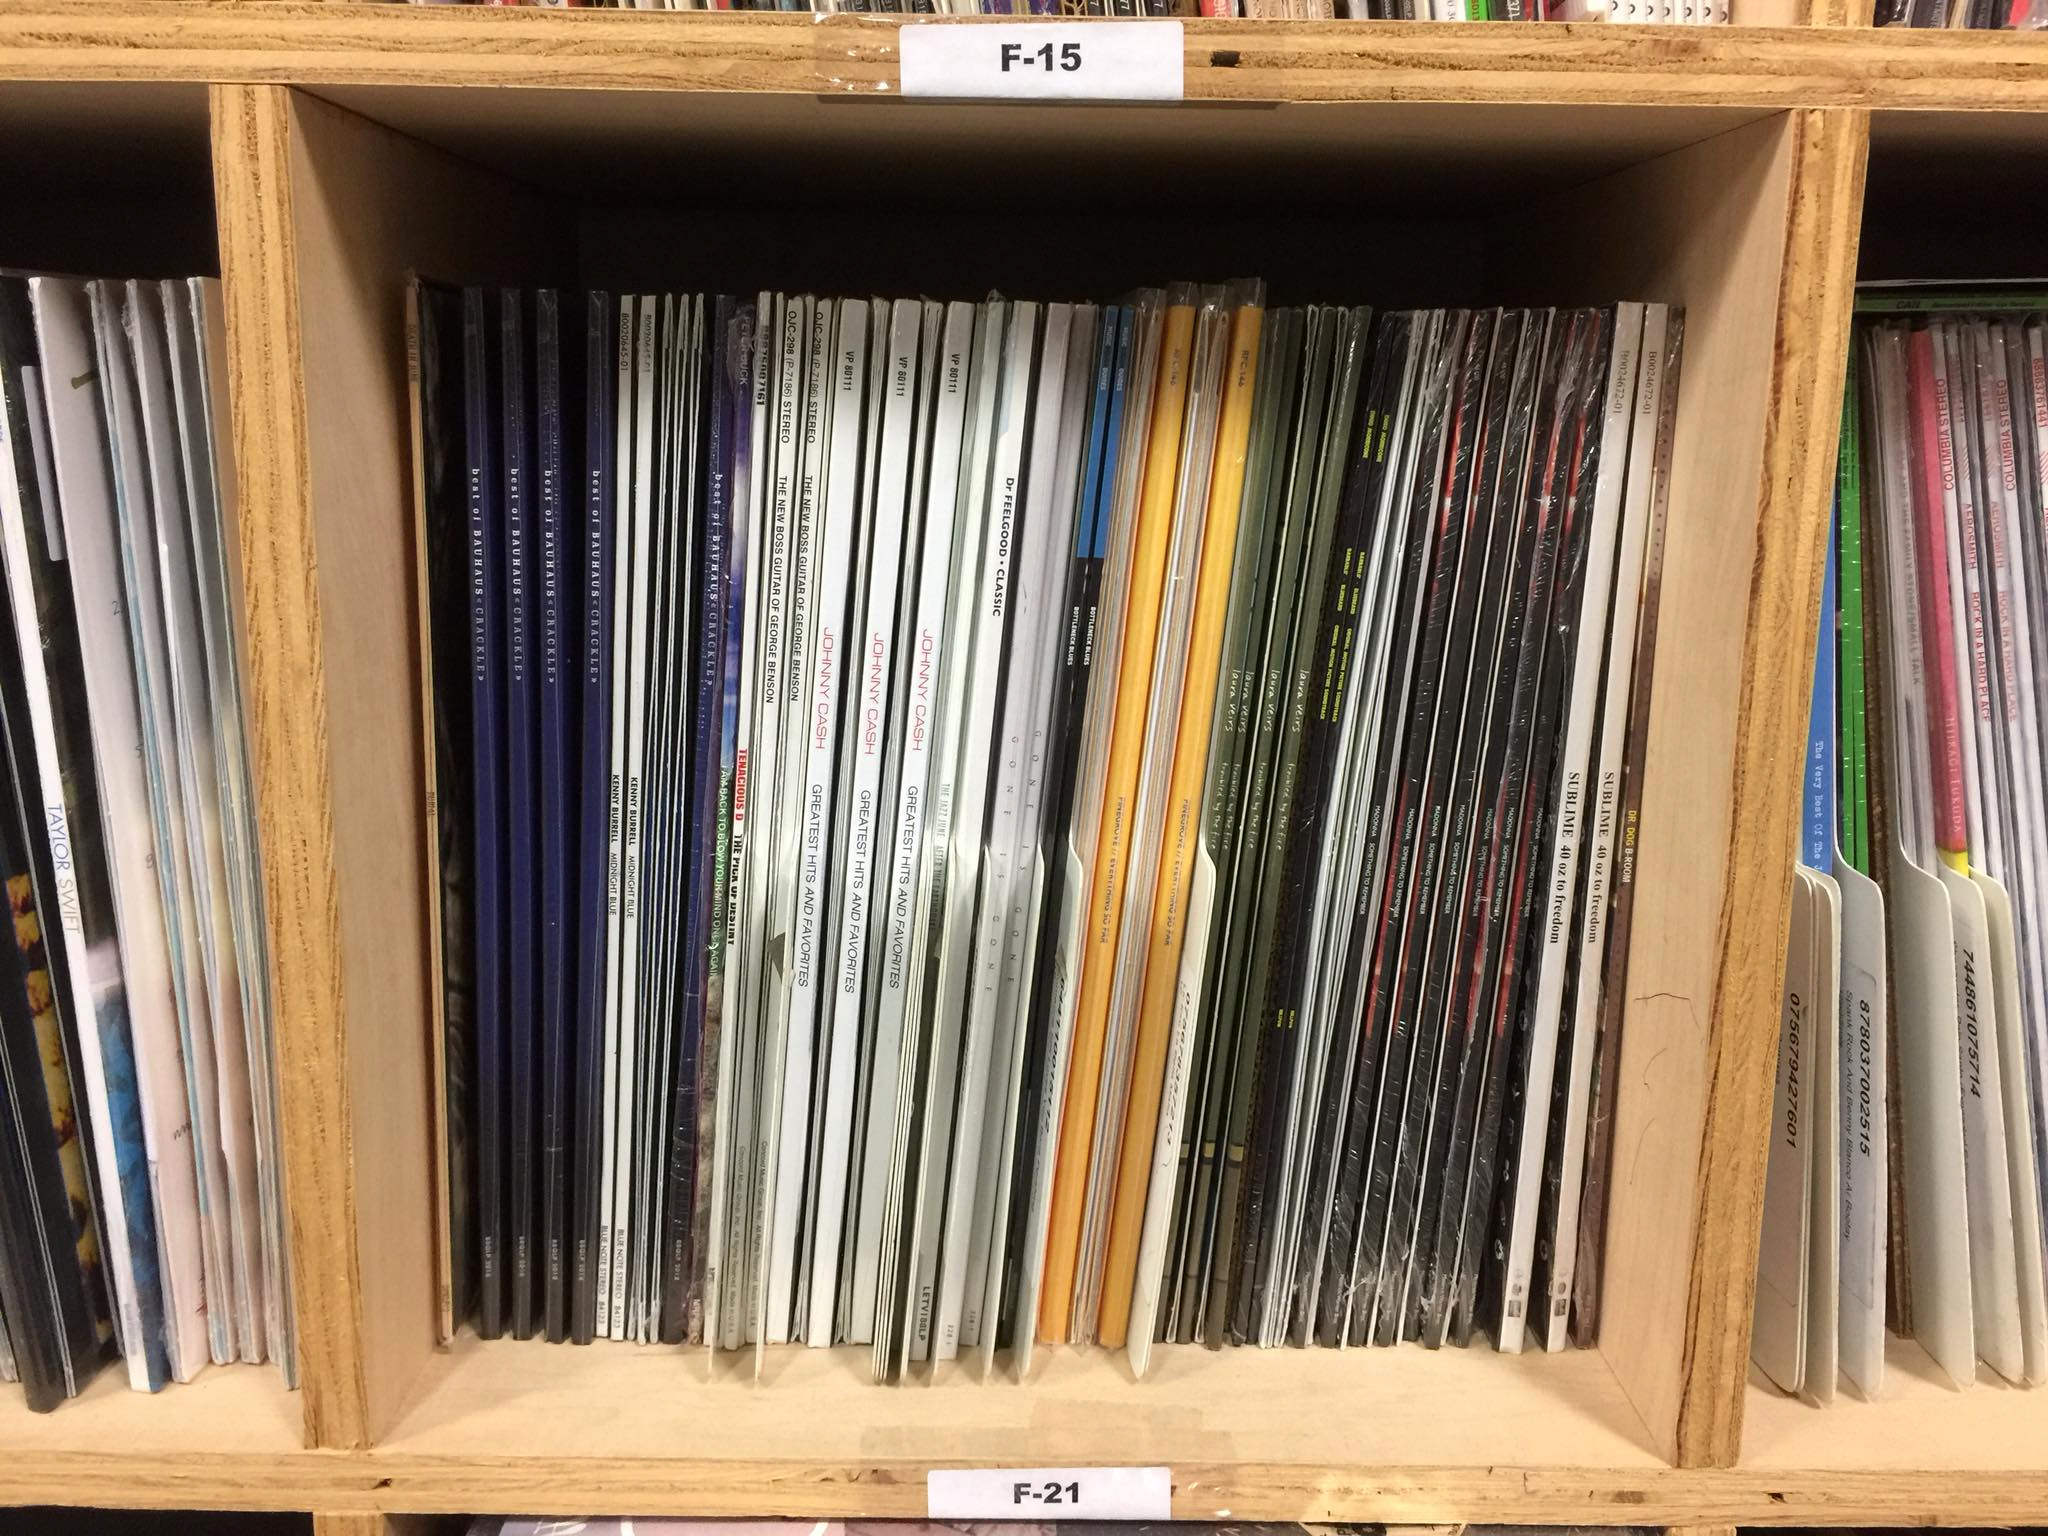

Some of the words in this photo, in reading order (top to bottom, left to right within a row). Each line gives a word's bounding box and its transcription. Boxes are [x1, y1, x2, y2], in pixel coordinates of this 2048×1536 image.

[1000, 43, 1083, 72] F-15
[784, 310, 798, 355] OJC-298
[811, 311, 824, 356] OJC-298
[844, 351, 855, 363] VP
[897, 356, 908, 369] VP
[949, 353, 961, 366] VP
[782, 357, 795, 398] (P-7186)
[808, 357, 821, 398] (P-7186)
[842, 365, 854, 391] 80111
[896, 370, 907, 397] 80111
[947, 367, 960, 393] 80111
[1936, 378, 1949, 426] STEREO
[1995, 379, 2010, 427] STEREO
[779, 400, 793, 444] STEREO
[805, 401, 819, 444] STEREO
[1939, 429, 1955, 491] COLUMBIA
[2000, 432, 2016, 491] COLUMBIA
[471, 468, 481, 500] best
[591, 470, 601, 502] best
[776, 475, 788, 497] THE
[802, 475, 814, 497] THE
[1004, 477, 1015, 492] Dr
[472, 507, 482, 521] of
[591, 510, 601, 524] of
[775, 499, 787, 523] NEW
[801, 499, 813, 522] NEW
[998, 494, 1013, 557] FEELGOOD
[773, 525, 786, 555] BOSS
[799, 524, 812, 554] BOSS
[473, 530, 484, 595] BAUHAUS
[591, 532, 600, 597] BAUHAUS
[771, 557, 784, 595] GUITAR
[797, 556, 810, 594] GUITAR
[770, 597, 782, 613] OF
[796, 596, 807, 611] OF
[992, 568, 1007, 617] CLASSIC
[1970, 591, 1983, 624] ROCK
[767, 614, 781, 658] GEORGE
[793, 613, 806, 657] GEORGE
[1069, 606, 1080, 645] BOTTLENECK
[1085, 606, 1097, 645] BOTTLENECK
[1973, 627, 1984, 639] IN
[818, 627, 834, 699] JOHNNY
[868, 632, 884, 704] JOHNNY
[916, 629, 933, 701] JOHNNY
[1067, 646, 1076, 666] BLUES
[1083, 646, 1093, 666] BLUES
[1975, 651, 1988, 684] HARD
[765, 661, 778, 704] BENSON
[790, 658, 804, 701] BENSON
[1267, 669, 1281, 699] laura
[1296, 669, 1310, 699] laura
[814, 702, 829, 750] CASH
[863, 708, 879, 755] CASH
[910, 704, 927, 751] CASH
[1263, 703, 1276, 732] veirs
[1291, 704, 1305, 733] veirs
[1814, 741, 1824, 759] The
[719, 770, 729, 785] AM
[735, 749, 748, 810] TENACIOUS
[1003, 736, 1019, 816] GONE
[1026, 730, 1042, 810] GONE
[1814, 765, 1824, 789] Very
[610, 774, 620, 807] KENNY
[629, 777, 638, 808] KENNY
[1561, 772, 1580, 838] SUBLIME
[1598, 772, 1615, 838] SUBLIME
[807, 784, 823, 851] GREATEST
[901, 785, 919, 853] GREATEST
[1370, 805, 1382, 837] MADONNA
[1814, 795, 1824, 818] Best
[46, 804, 72, 871] TAYLOR
[610, 808, 620, 843] BURRELL
[628, 809, 638, 846] BURRELL
[717, 817, 726, 831] TO
[855, 789, 872, 857] GREATEST
[1278, 815, 1290, 833] the
[1404, 808, 1416, 840] MADONNA
[1625, 827, 1636, 846] DOG
[1814, 824, 1823, 836] Of
[715, 833, 725, 861] BLOW
[732, 834, 743, 854] THE
[1019, 845, 1030, 872] IS
[1365, 842, 1376, 875] SOMETHING
[1559, 845, 1571, 859] 40
[1596, 845, 1607, 859] 40
[1813, 841, 1823, 860] The
[609, 853, 619, 894] MIDNIGHT
[627, 855, 637, 896] MIDNIGHT
[805, 854, 818, 883] HITS
[852, 860, 866, 889] HITS
[898, 856, 912, 885] HITS
[997, 852, 1008, 879] IS
[1398, 845, 1410, 879] SOMETHING
[1557, 862, 1569, 877] oz
[1594, 862, 1606, 877] oz
[1622, 848, 1634, 883] B-ROOM
[1363, 876, 1372, 885] TO
[1397, 880, 1405, 888] TO
[1555, 880, 1568, 892] to
[1593, 879, 1604, 891] to
[57, 878, 81, 934] SWIFT
[609, 896, 618, 916] BLUE
[627, 898, 636, 919] BLUE
[712, 892, 722, 917] MIND
[802, 887, 815, 915] AND
[850, 893, 863, 921] AND
[895, 888, 910, 917] AND
[1359, 885, 1371, 915] REMEMBER
[1393, 888, 1404, 918] REMEMBER
[1550, 894, 1566, 944] freedom
[1587, 894, 1602, 943] freedom
[798, 918, 813, 987] FAVORITES
[844, 924, 861, 993] FAVORITES
[889, 919, 907, 989] FAVORITES
[984, 915, 1000, 992] GONE
[1007, 906, 1022, 983] GONE
[1962, 948, 1981, 1098] 744861075714
[1785, 992, 1801, 1149] 075679427601
[1859, 999, 1871, 1158] 878037002515
[615, 1228, 625, 1247] BLUE
[614, 1248, 624, 1269] NOTE
[614, 1270, 624, 1299] STEREO
[1013, 1482, 1081, 1504] F-21
